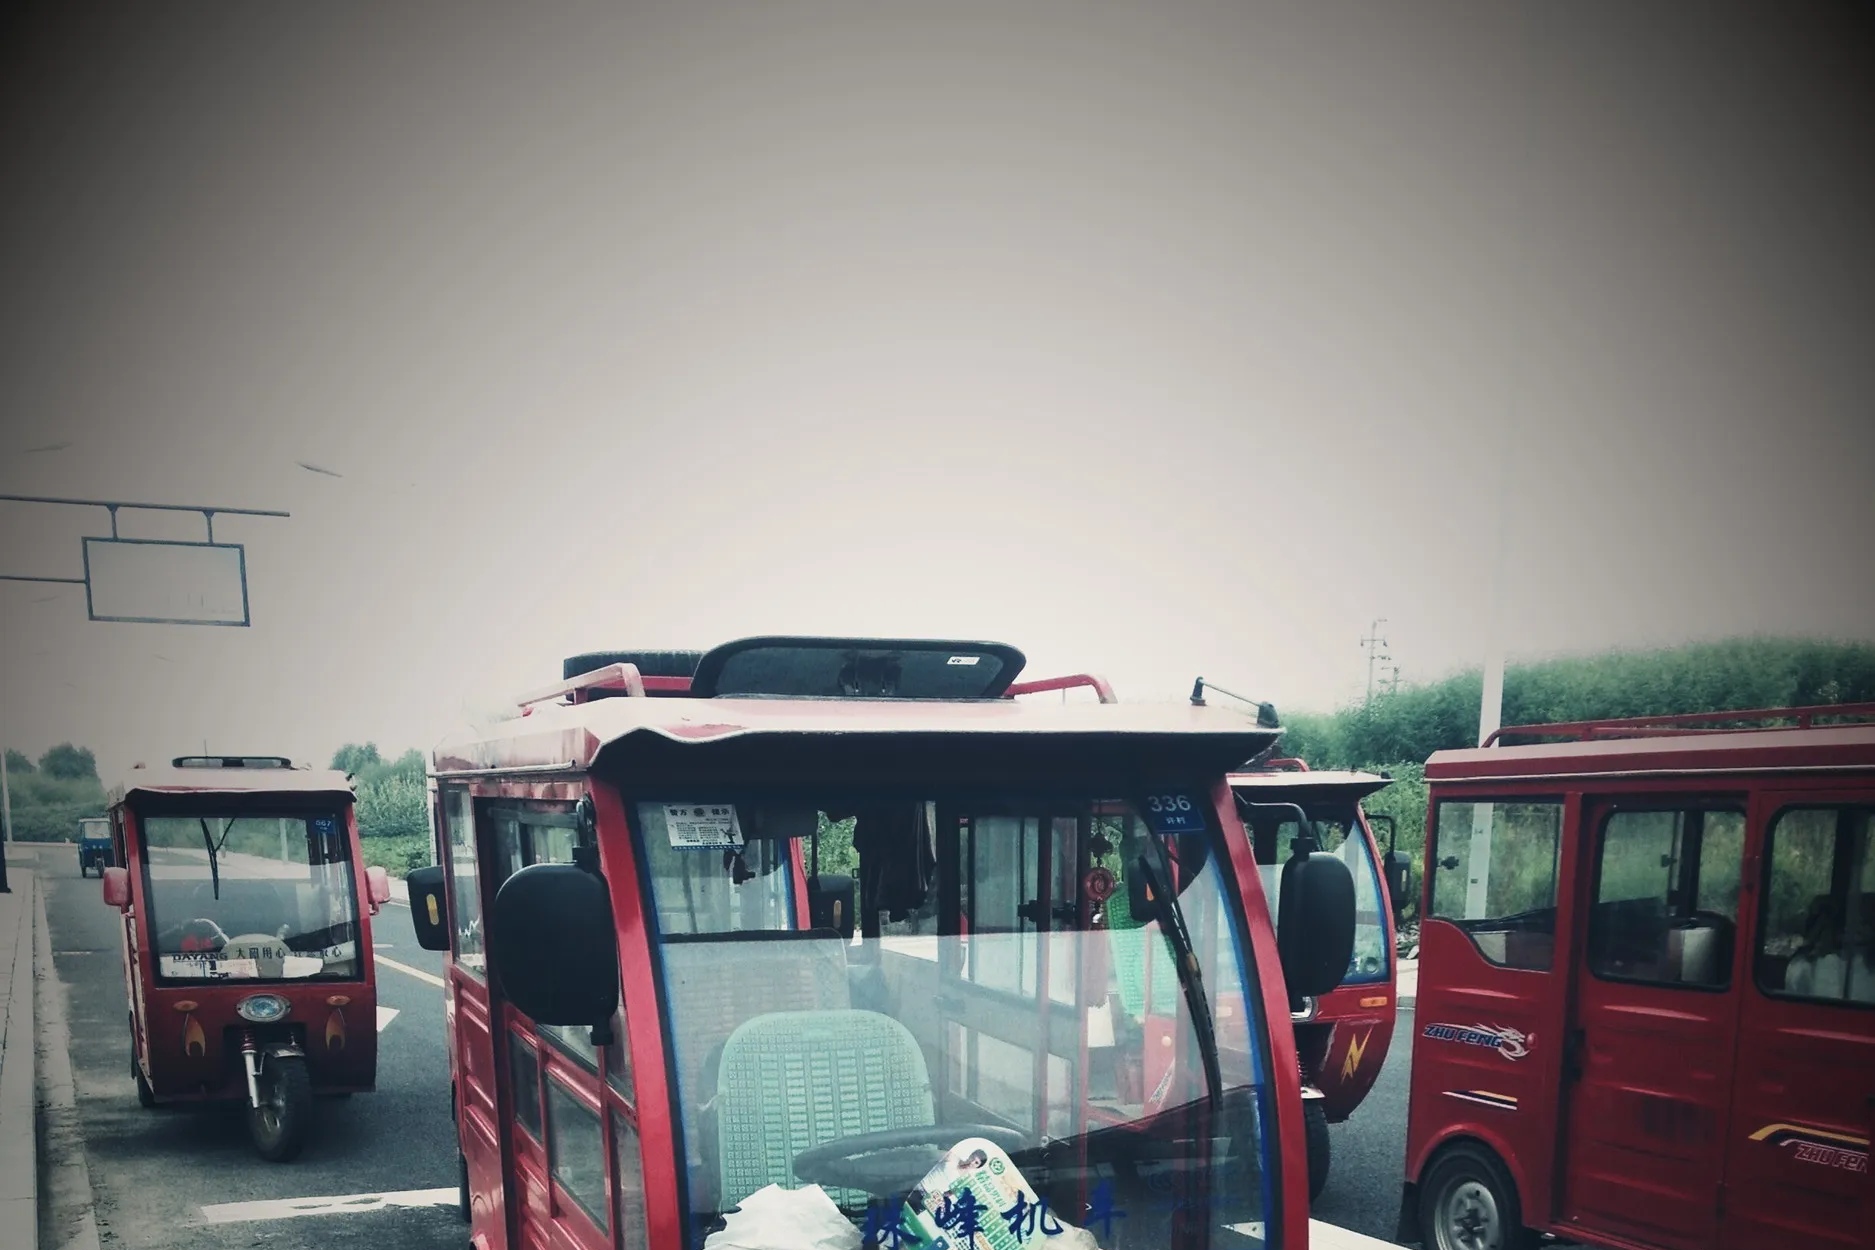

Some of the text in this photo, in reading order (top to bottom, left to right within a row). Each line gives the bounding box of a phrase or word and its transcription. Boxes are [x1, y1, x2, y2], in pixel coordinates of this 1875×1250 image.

[1147, 795, 1191, 812] 336
[172, 953, 228, 962] DAYANG
[1422, 1025, 1457, 1041] ZHU
[1794, 1143, 1835, 1165] ZHU
